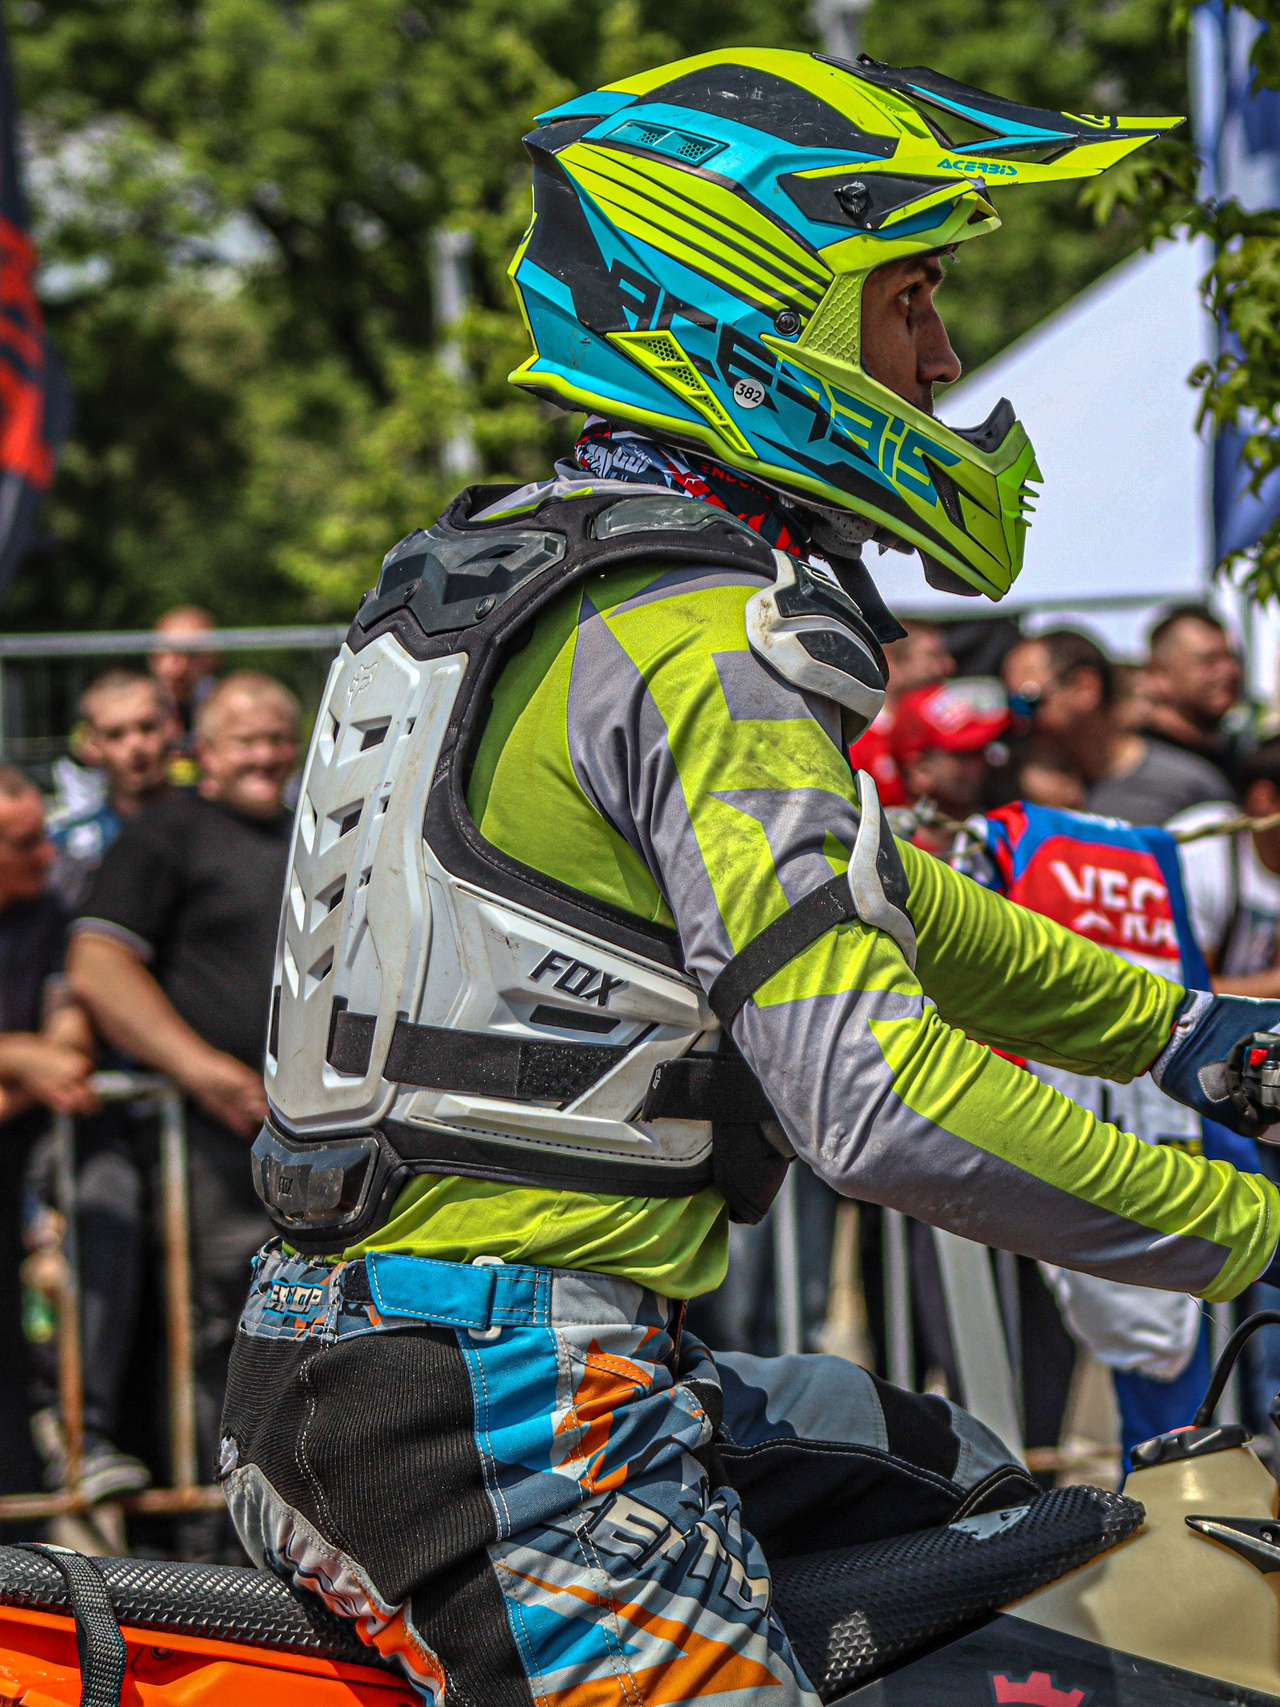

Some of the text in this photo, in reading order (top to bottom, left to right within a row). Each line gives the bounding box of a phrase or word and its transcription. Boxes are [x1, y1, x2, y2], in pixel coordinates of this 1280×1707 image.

[937, 158, 1017, 176] ACERBIS
[735, 383, 761, 404] 382
[527, 948, 626, 1006] FOX
